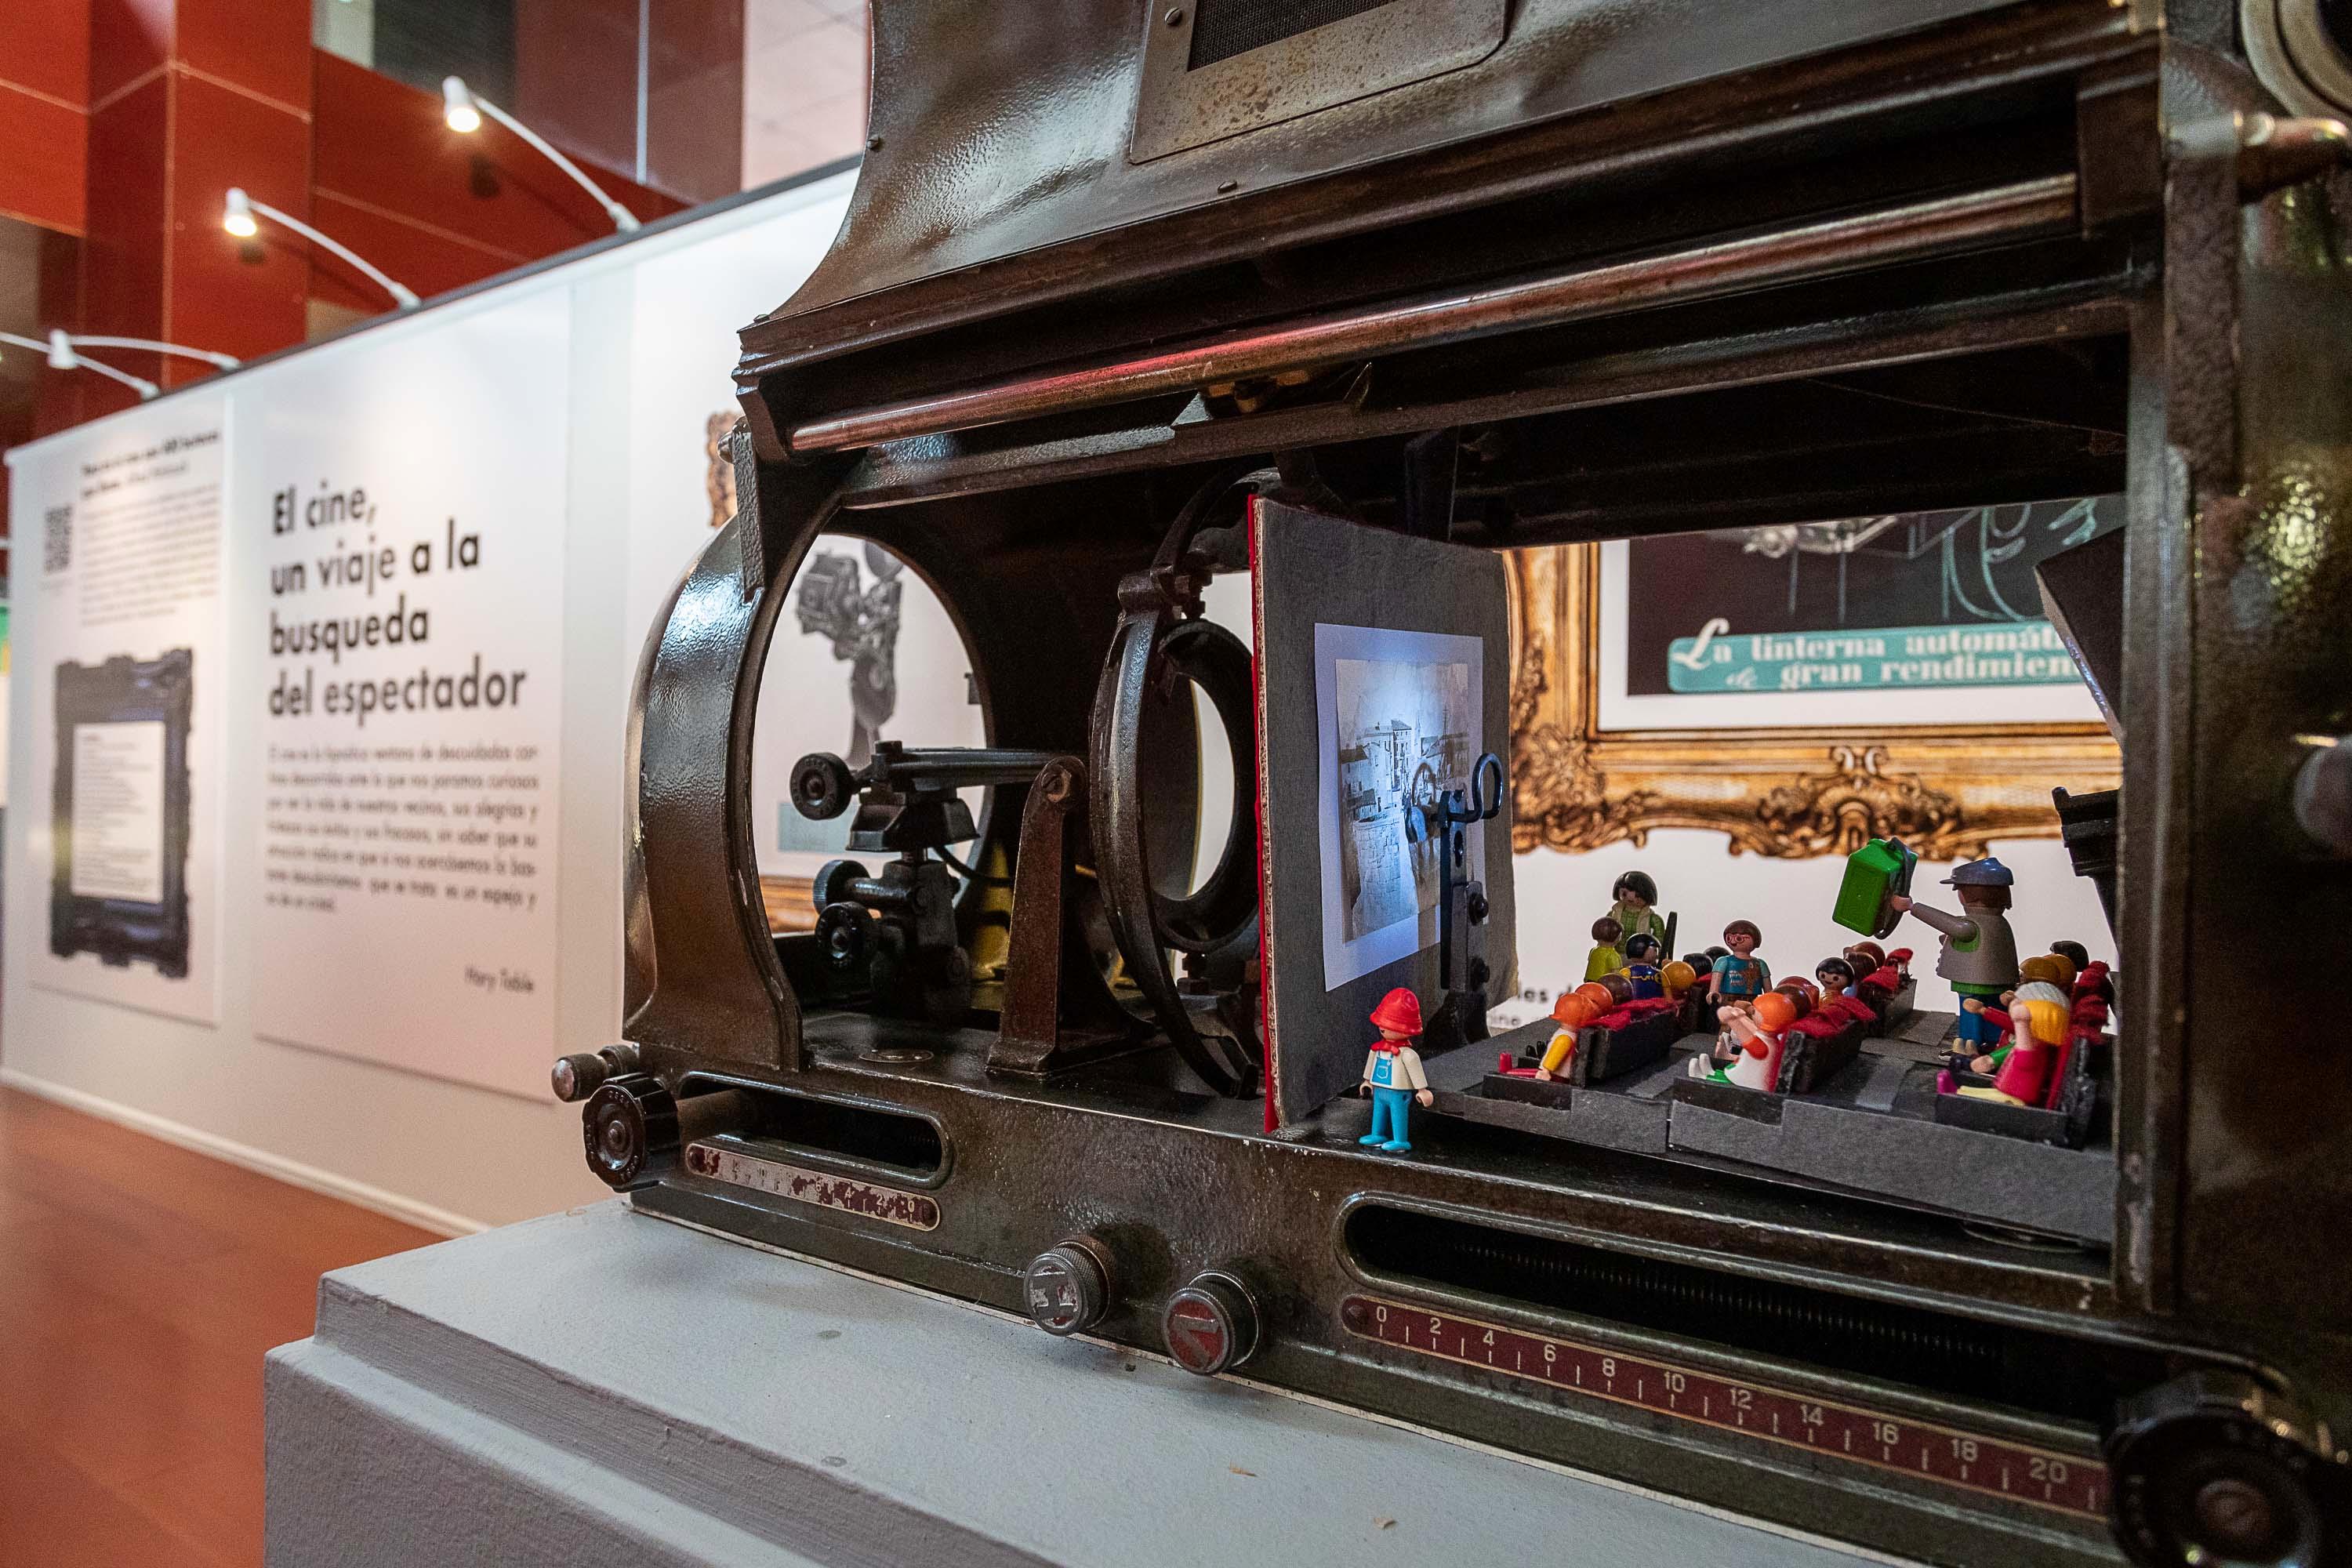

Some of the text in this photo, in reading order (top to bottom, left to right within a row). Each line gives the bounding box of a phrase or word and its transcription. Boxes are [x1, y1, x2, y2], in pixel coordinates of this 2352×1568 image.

[274, 480, 375, 535] El cine,
[271, 517, 478, 597] un viaje a la
[270, 593, 428, 665] busqueda
[1671, 617, 1733, 670] La
[1751, 635, 1886, 662] linterna
[269, 653, 526, 728] del espectador
[1780, 662, 1862, 689] gran
[1881, 650, 2082, 681] rendimien
[877, 1193, 884, 1206] 2
[907, 1200, 915, 1214] 0
[1376, 1305, 2067, 1484] 0 2 4 6 8 10 12 14 16 18 20
